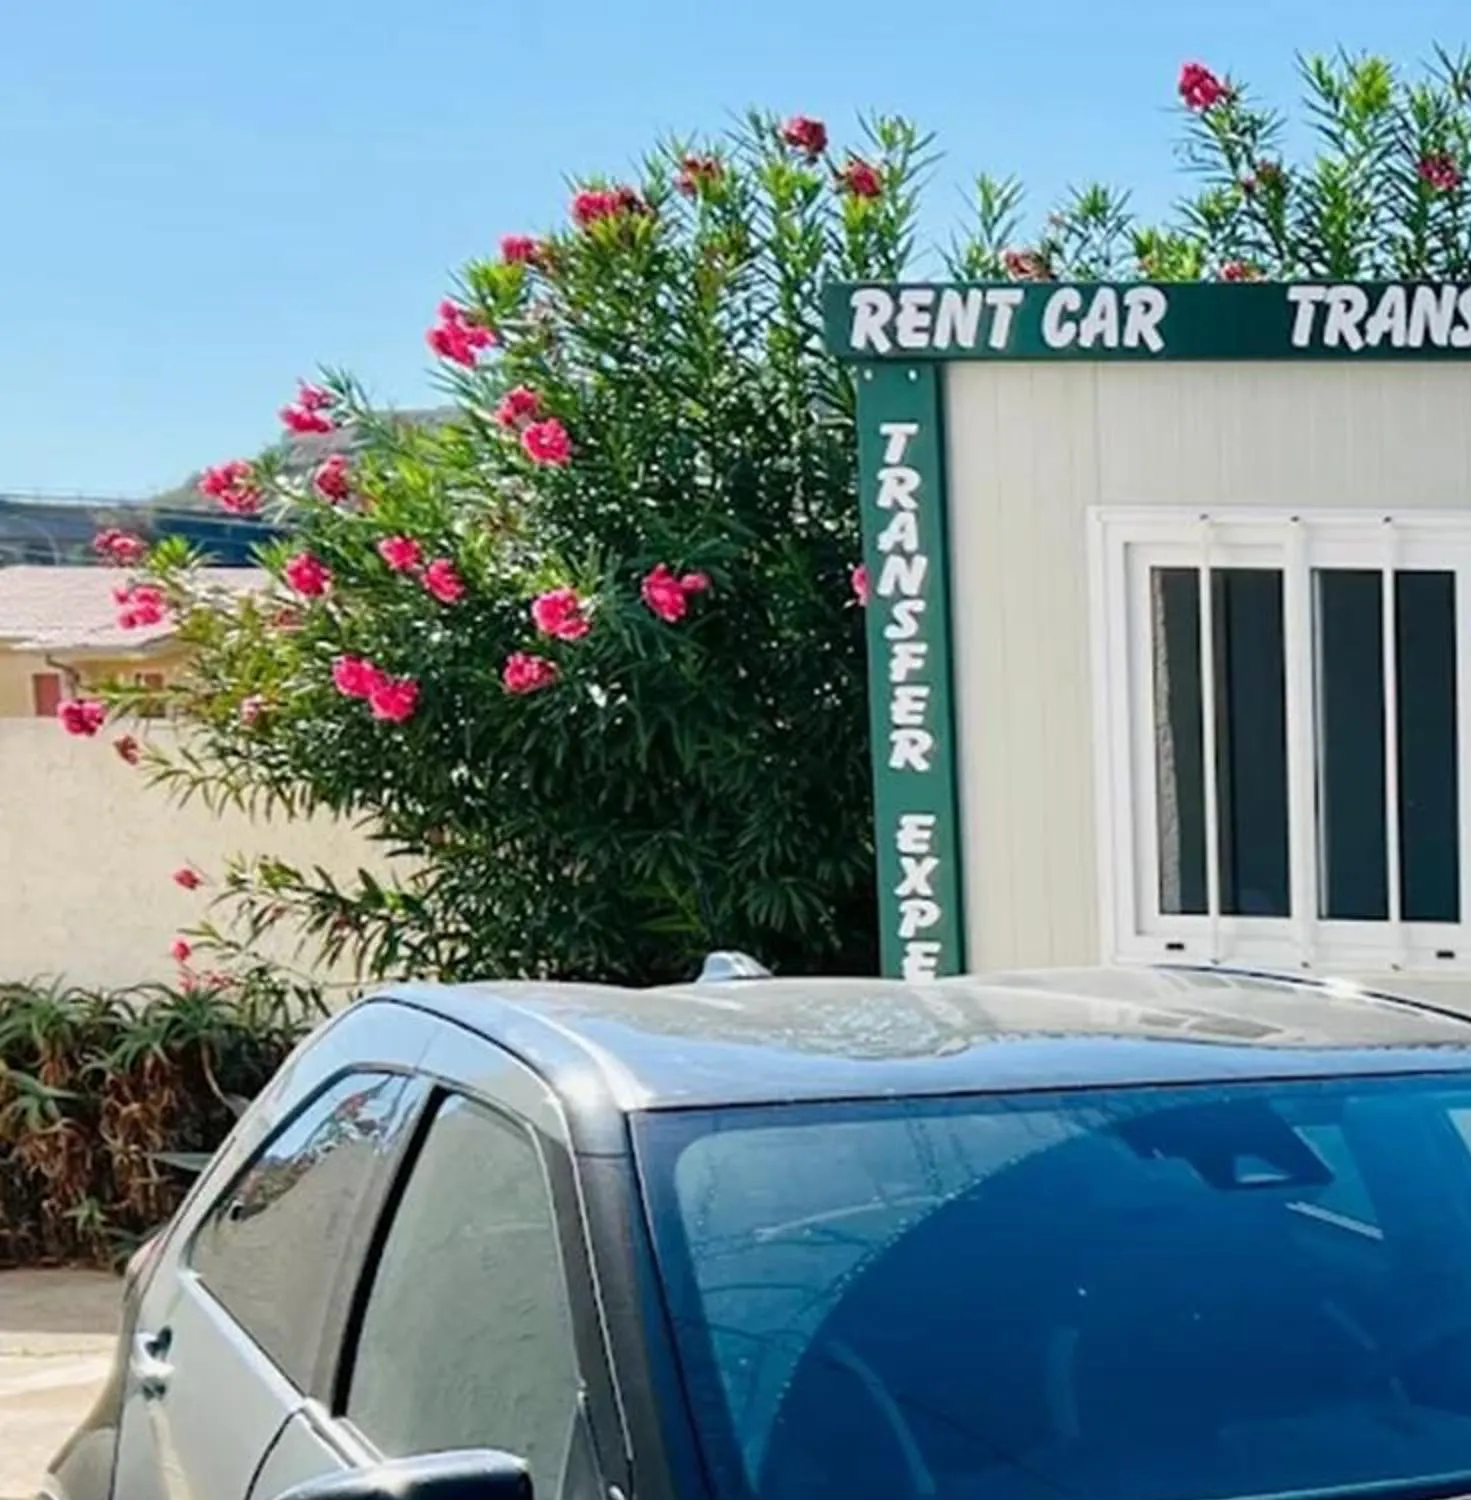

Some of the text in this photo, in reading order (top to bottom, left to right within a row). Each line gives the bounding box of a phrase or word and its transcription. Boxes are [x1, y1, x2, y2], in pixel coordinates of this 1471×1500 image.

[850, 287, 1168, 352] RENT CAR
[876, 423, 934, 772] TRANSFER
